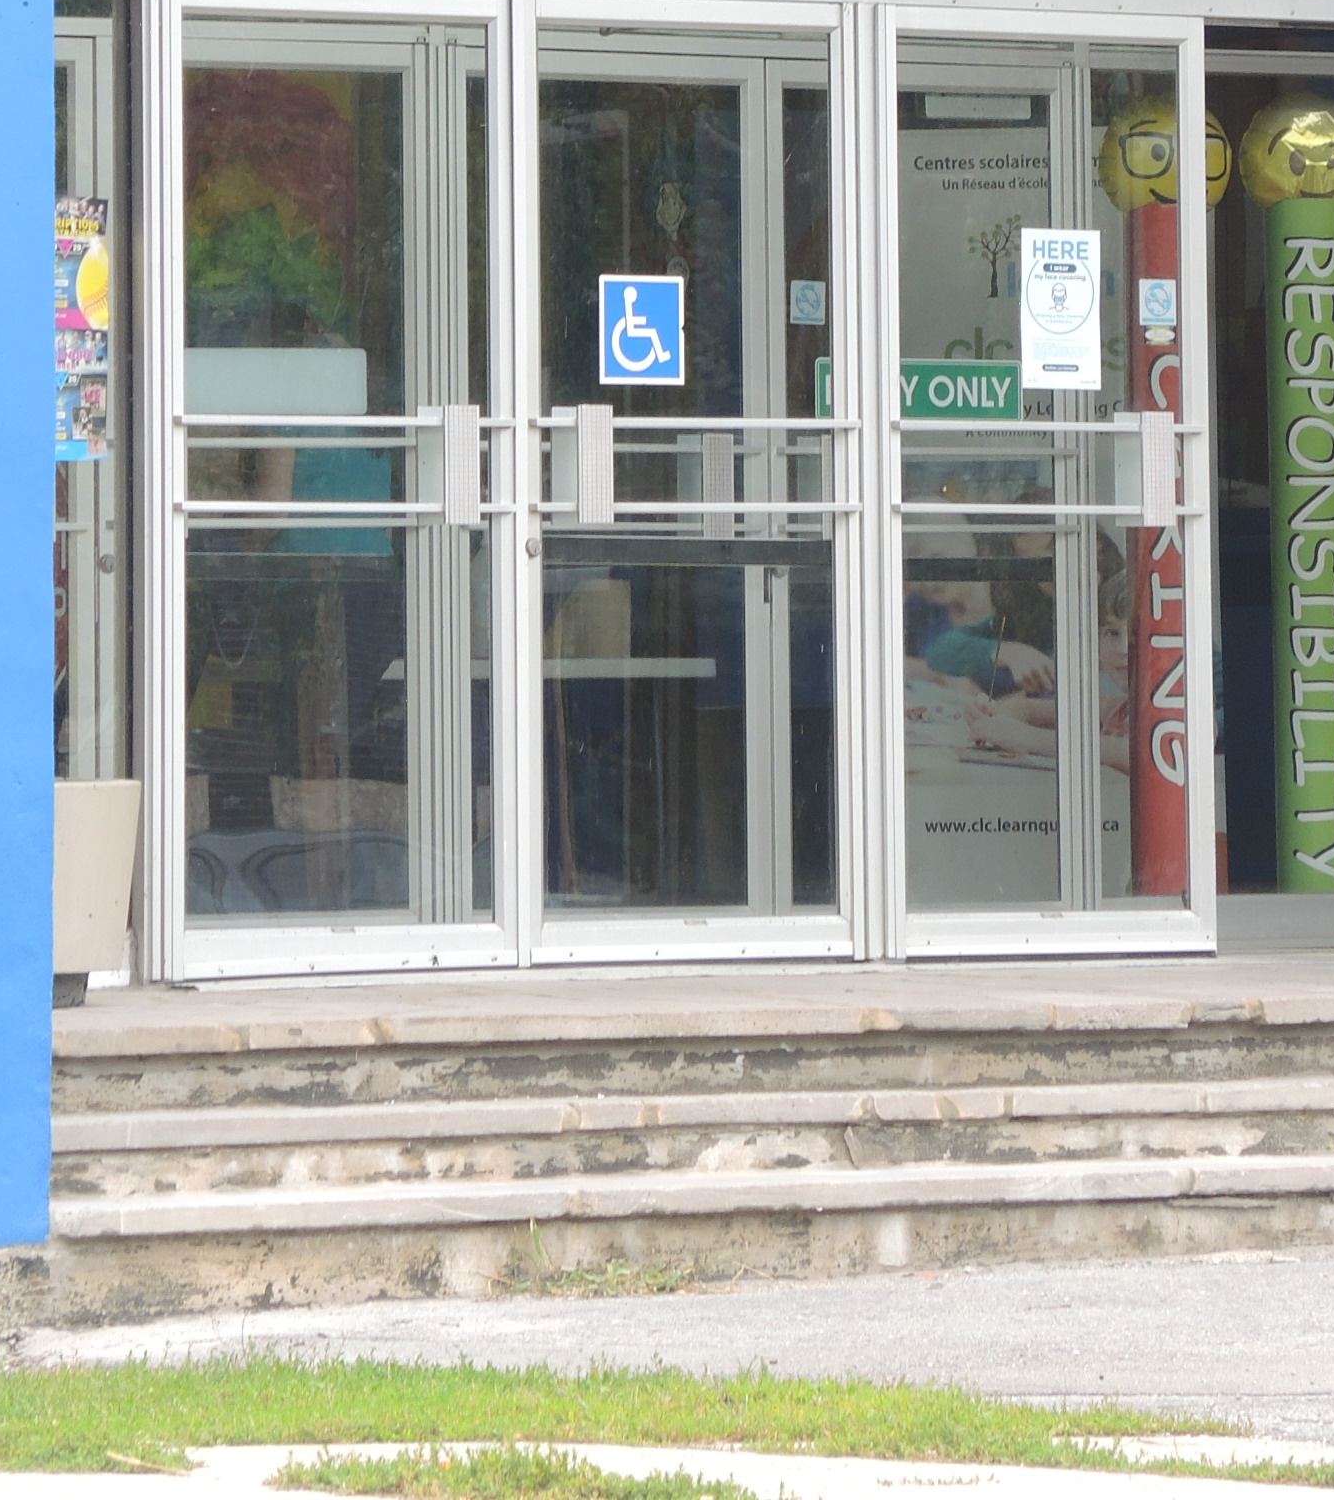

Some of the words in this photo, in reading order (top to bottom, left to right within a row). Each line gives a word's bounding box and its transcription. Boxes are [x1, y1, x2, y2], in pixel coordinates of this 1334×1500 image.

[914, 155, 975, 171] Centres
[979, 153, 1049, 170] scolaires
[942, 179, 959, 190] Un
[962, 177, 1005, 190] Réseau
[1033, 239, 1089, 260] HERE
[928, 375, 1012, 408] ONLY
[1150, 352, 1186, 788] CING
